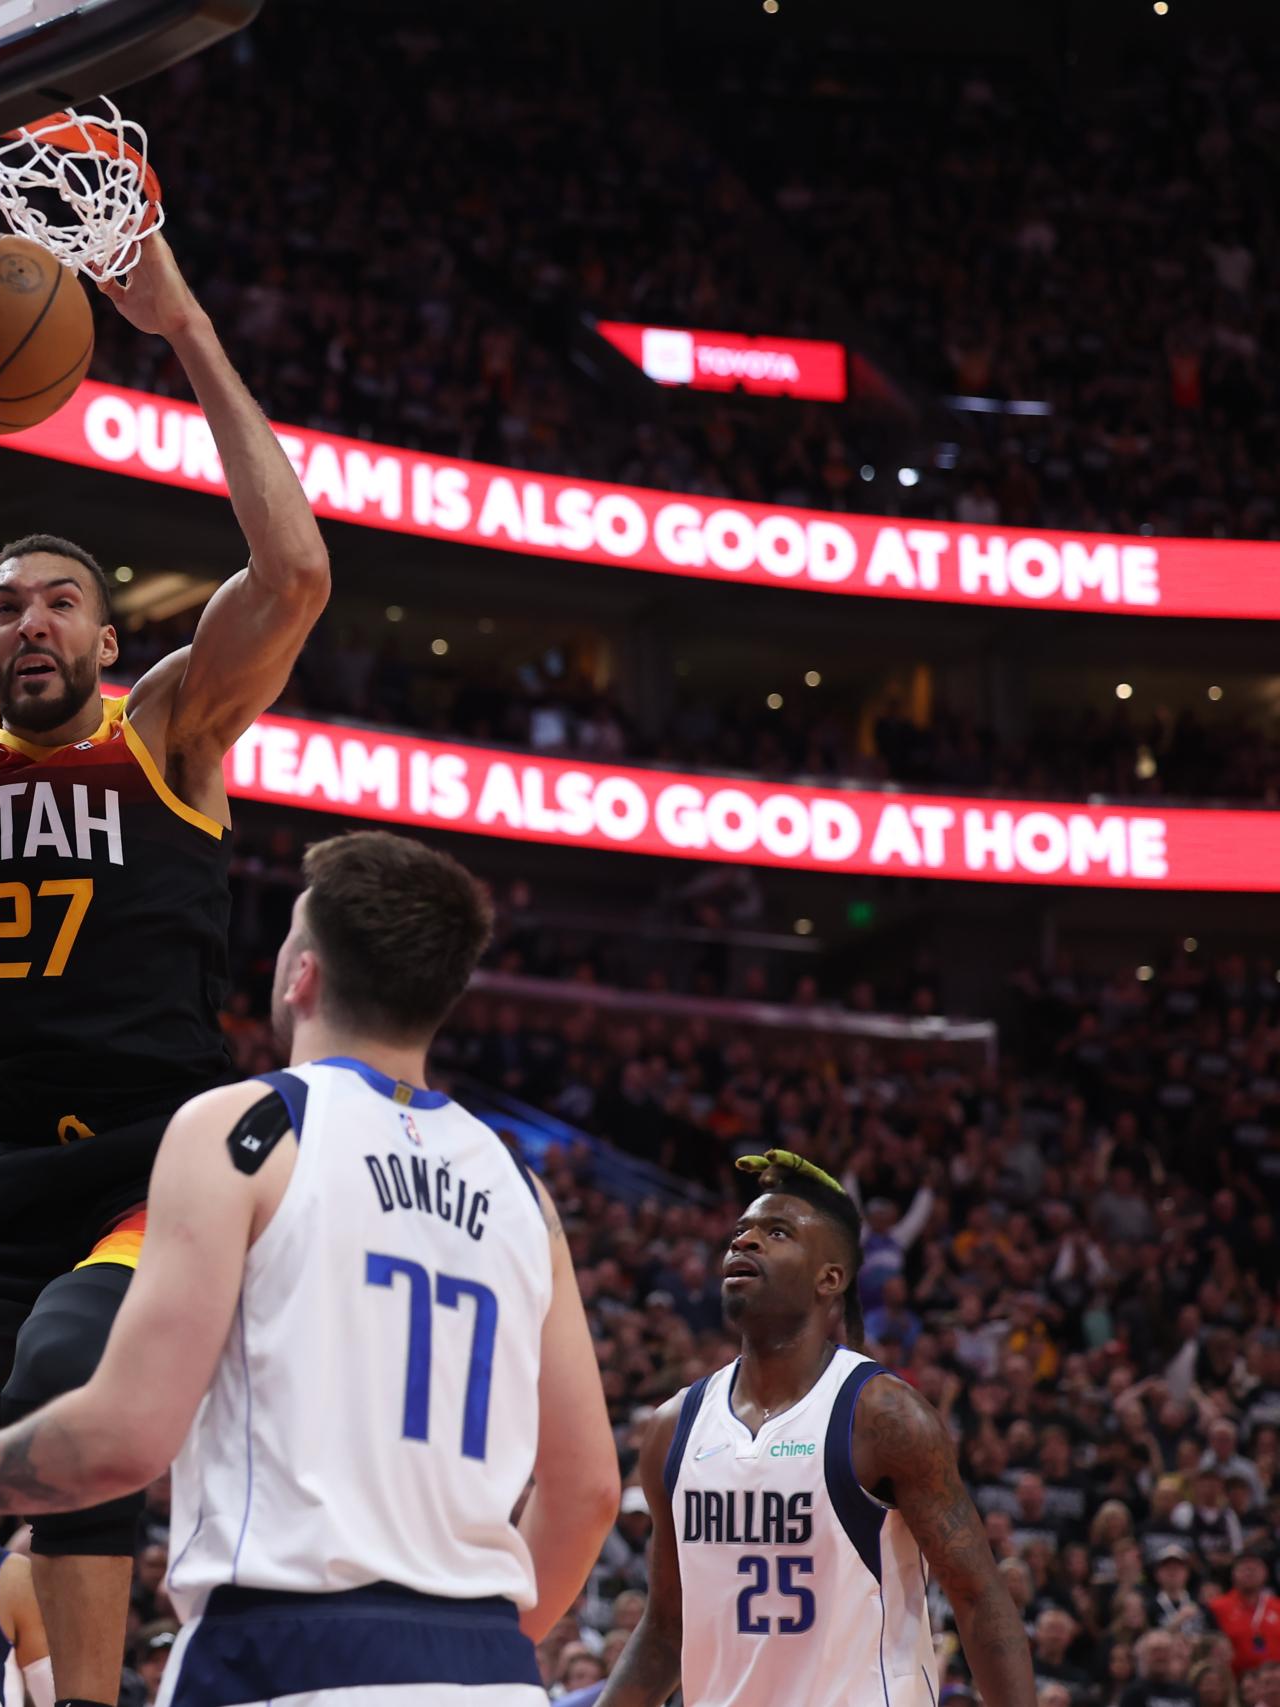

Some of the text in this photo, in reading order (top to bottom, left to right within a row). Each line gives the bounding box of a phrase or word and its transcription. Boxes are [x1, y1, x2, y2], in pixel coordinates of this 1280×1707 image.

[697, 345, 799, 382] TOYOTA
[84, 396, 223, 482] OUR
[412, 463, 472, 531] IS
[477, 477, 648, 557] ALSO
[653, 503, 858, 582] GOOD
[865, 527, 949, 590] AT
[958, 534, 1160, 605] HOME
[233, 722, 1168, 878] TEAM IS ALSO GOOD AT HOME
[365, 1153, 491, 1242] DONČIĆ
[365, 1251, 499, 1461] 77
[770, 1440, 816, 1457] chime
[682, 1489, 814, 1544] DALLAS
[737, 1555, 816, 1635] 25
